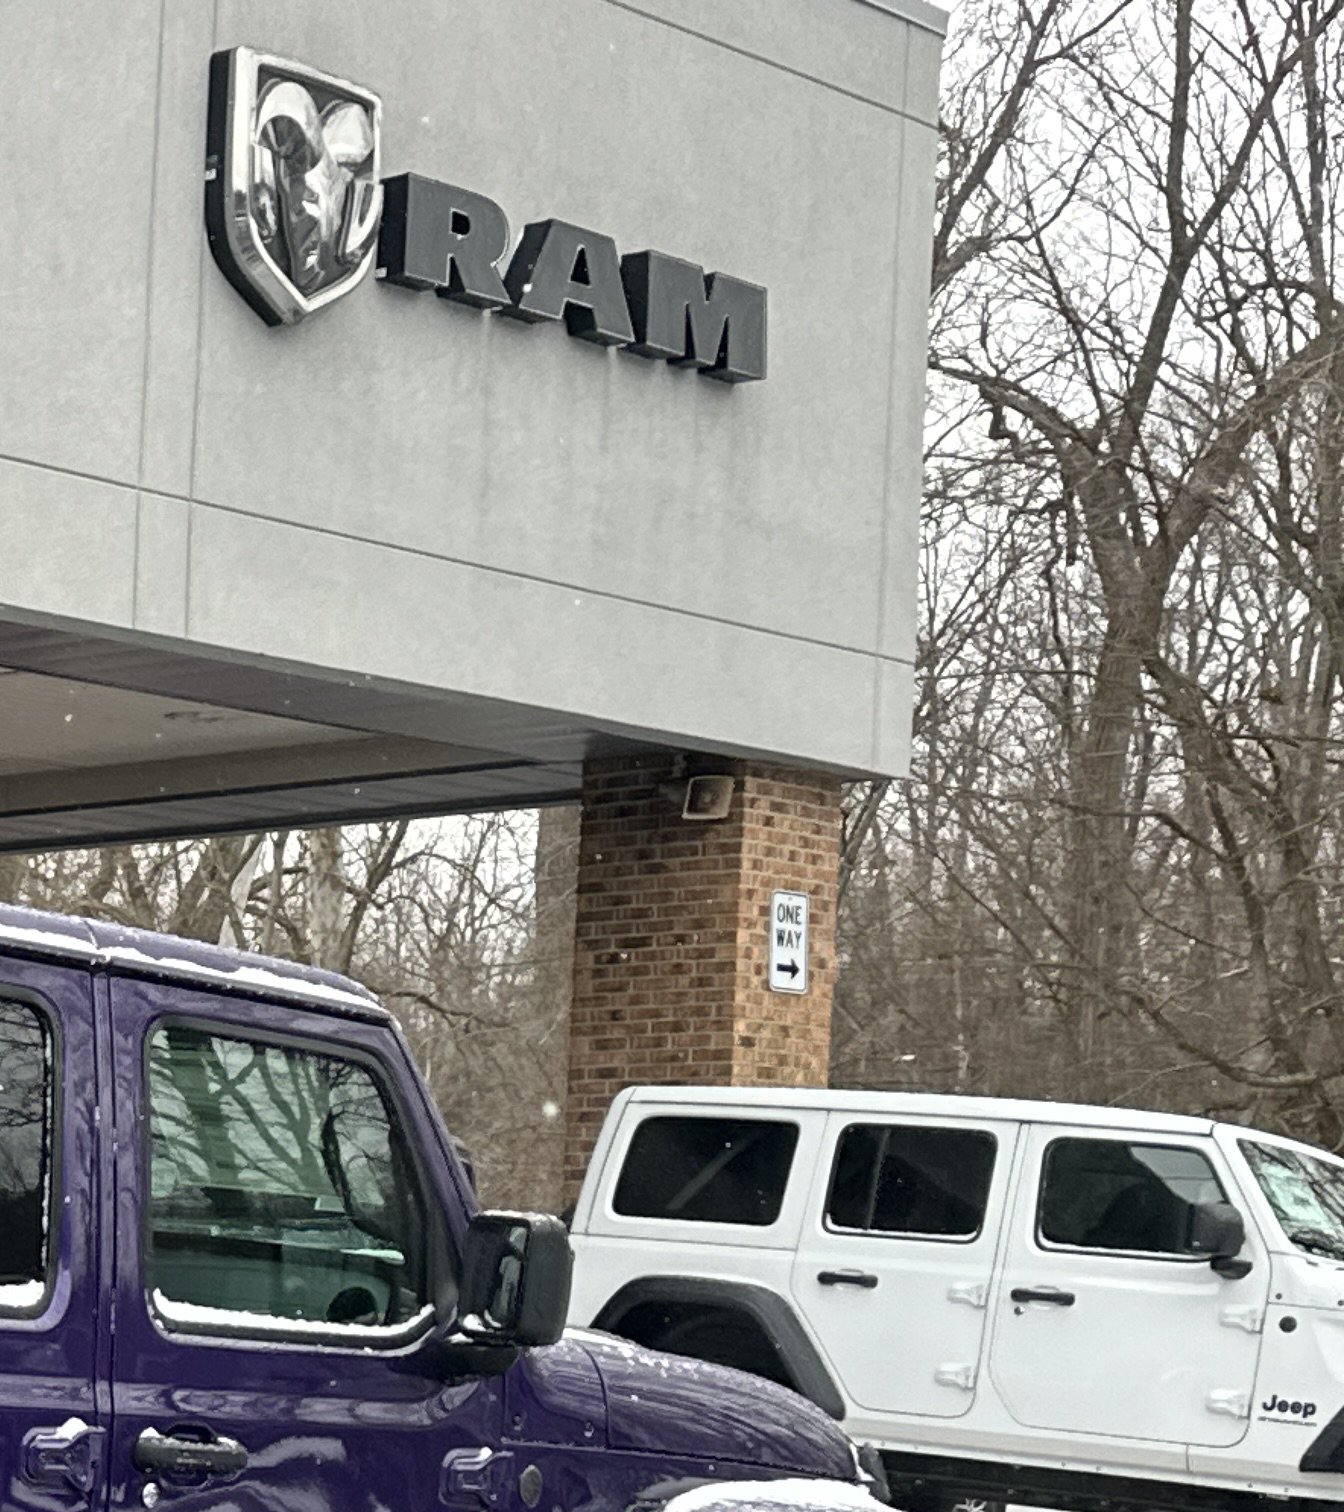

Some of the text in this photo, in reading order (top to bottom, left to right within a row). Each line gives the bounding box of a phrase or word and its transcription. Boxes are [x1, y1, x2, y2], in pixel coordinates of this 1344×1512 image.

[375, 171, 768, 384] RAM
[776, 903, 802, 925] ONE
[776, 928, 802, 949] WAY
[1262, 1394, 1317, 1418] Jeep
